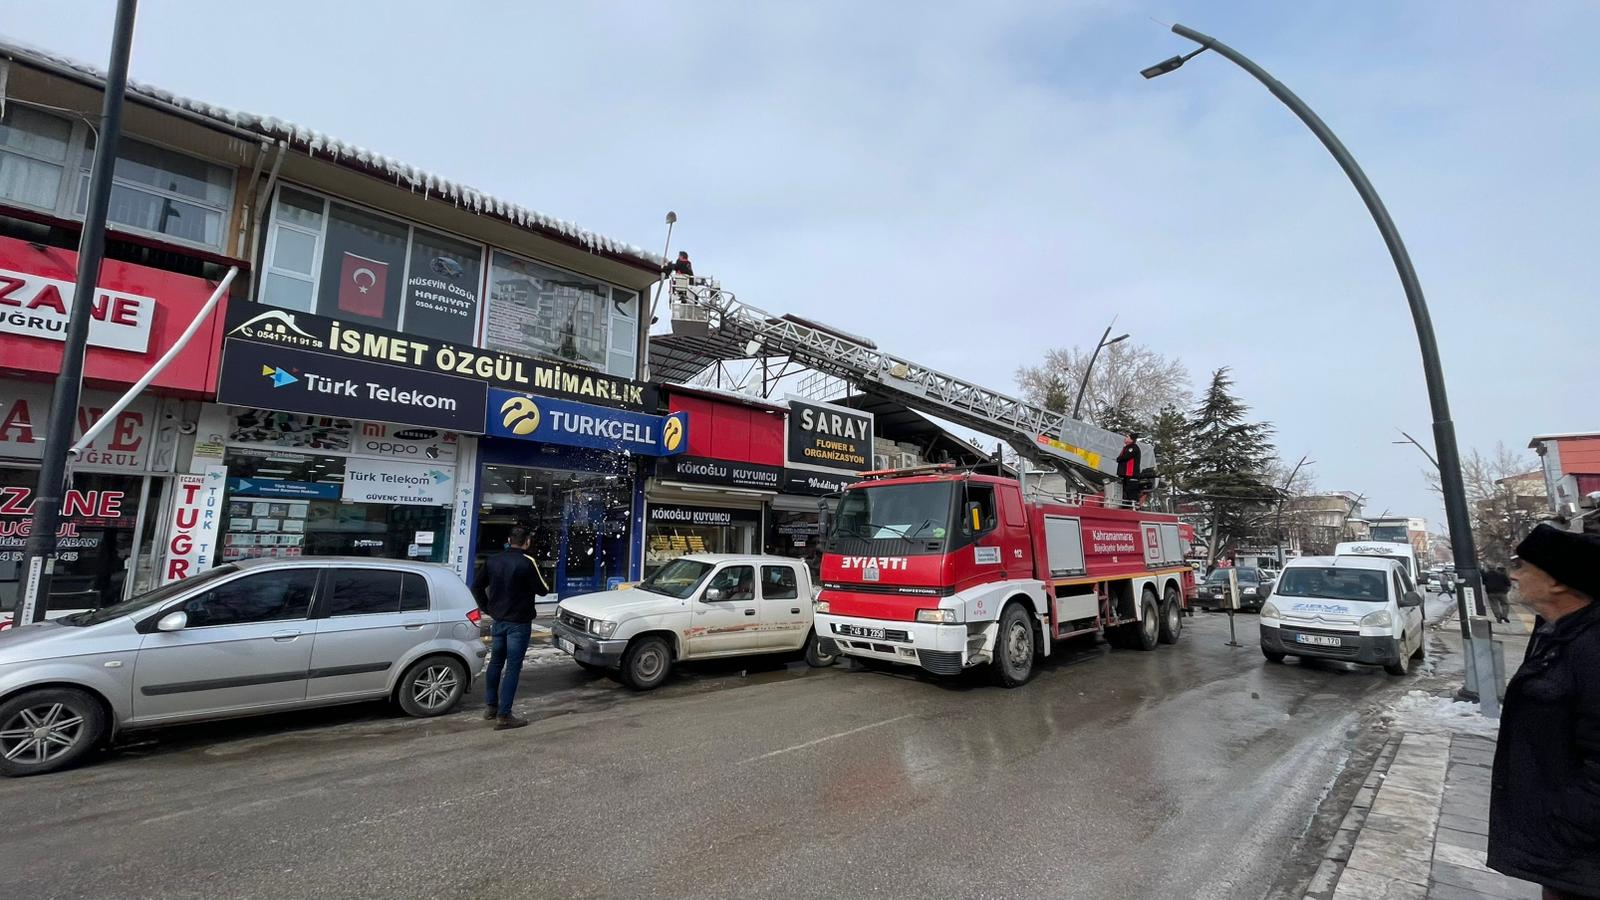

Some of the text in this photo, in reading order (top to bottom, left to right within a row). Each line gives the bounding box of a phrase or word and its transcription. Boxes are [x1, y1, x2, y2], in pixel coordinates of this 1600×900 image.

[448, 283, 476, 303] ÖZGÜL
[415, 300, 433, 309] 0506
[434, 304, 448, 313] 667
[257, 330, 323, 348] 0541 711 91 58
[329, 320, 428, 365] İSMET
[435, 343, 529, 384] ÖZGÜL
[533, 364, 644, 405] MİMARLIK
[303, 373, 457, 412] Türk Telekom
[549, 410, 657, 445] TURKCELL
[801, 408, 868, 441] SARAY
[366, 441, 418, 455] oppo
[816, 438, 856, 453] FLOWER &
[804, 447, 865, 465] ORGANİZASYON
[349, 470, 430, 486] Türk Telekom
[677, 461, 778, 482] KÖKOĞLU KUYUMCU
[808, 477, 839, 492] Wedding
[366, 493, 399, 502] GÜVENÇ
[202, 487, 217, 530] TÜRK
[651, 507, 731, 522] KÖKOĞLU KUYUMCU
